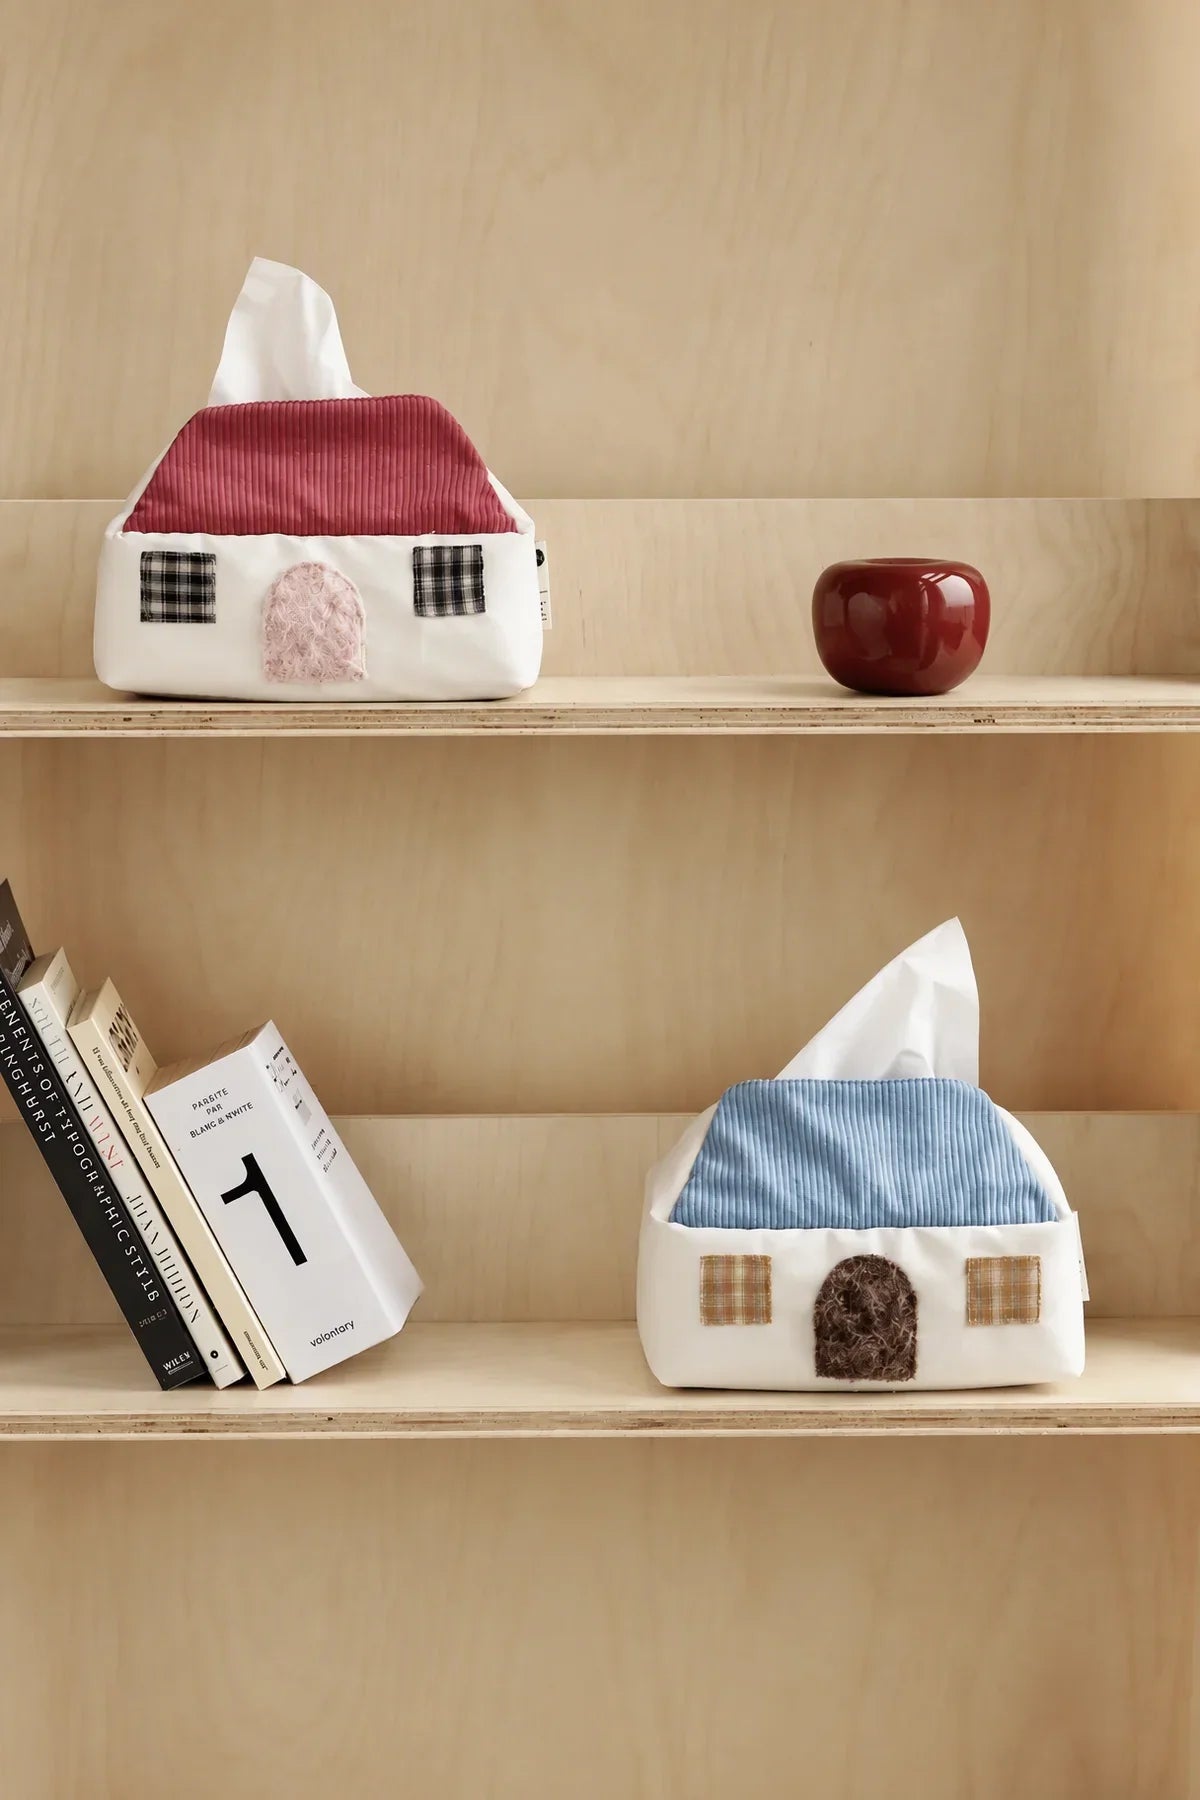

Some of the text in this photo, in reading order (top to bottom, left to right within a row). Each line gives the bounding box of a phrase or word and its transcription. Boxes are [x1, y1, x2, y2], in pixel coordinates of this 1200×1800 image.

[206, 1103, 223, 1115] PAR
[220, 1152, 308, 1267] 1
[310, 1320, 355, 1348] volontary
[162, 1351, 192, 1372] WILEY
